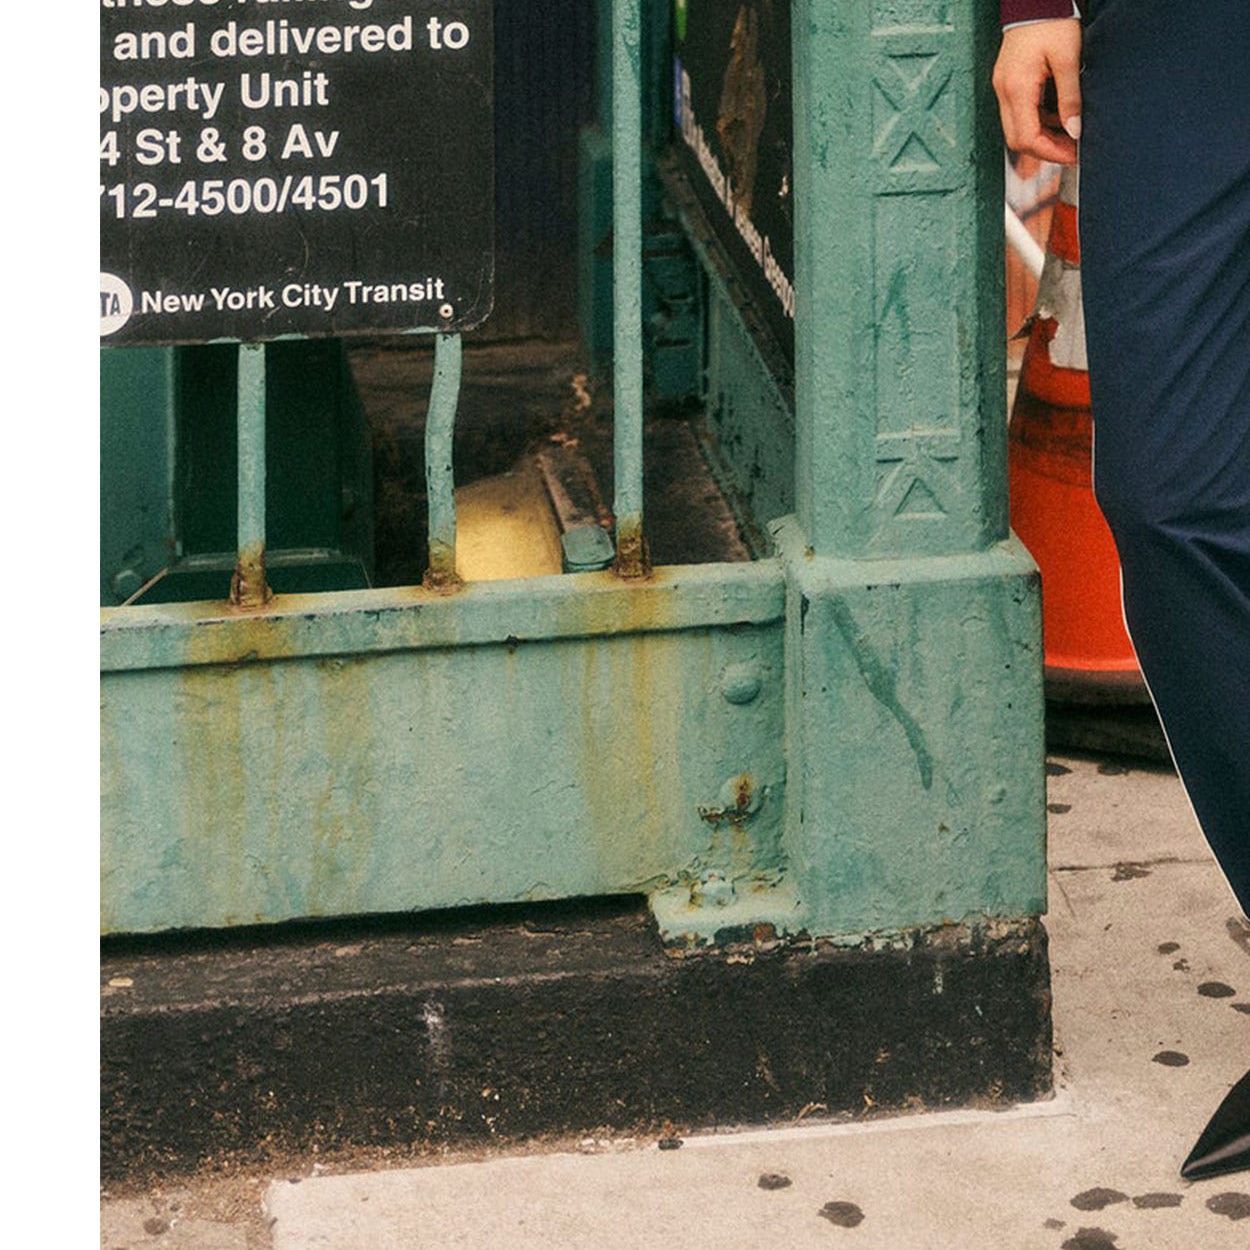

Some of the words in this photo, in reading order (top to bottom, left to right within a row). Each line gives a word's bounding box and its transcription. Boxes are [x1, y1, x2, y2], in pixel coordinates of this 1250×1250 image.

[113, 22, 195, 61] and
[210, 15, 412, 57] delivered
[426, 16, 470, 50] to
[240, 70, 329, 109] Unit
[135, 128, 182, 166] St
[196, 127, 228, 163] &
[242, 125, 267, 161] 8
[281, 123, 340, 159] Av
[101, 173, 387, 219] 12-4500/4501
[141, 290, 205, 314] New
[210, 285, 275, 311] York
[281, 283, 339, 311] City
[343, 277, 445, 304] Transit
